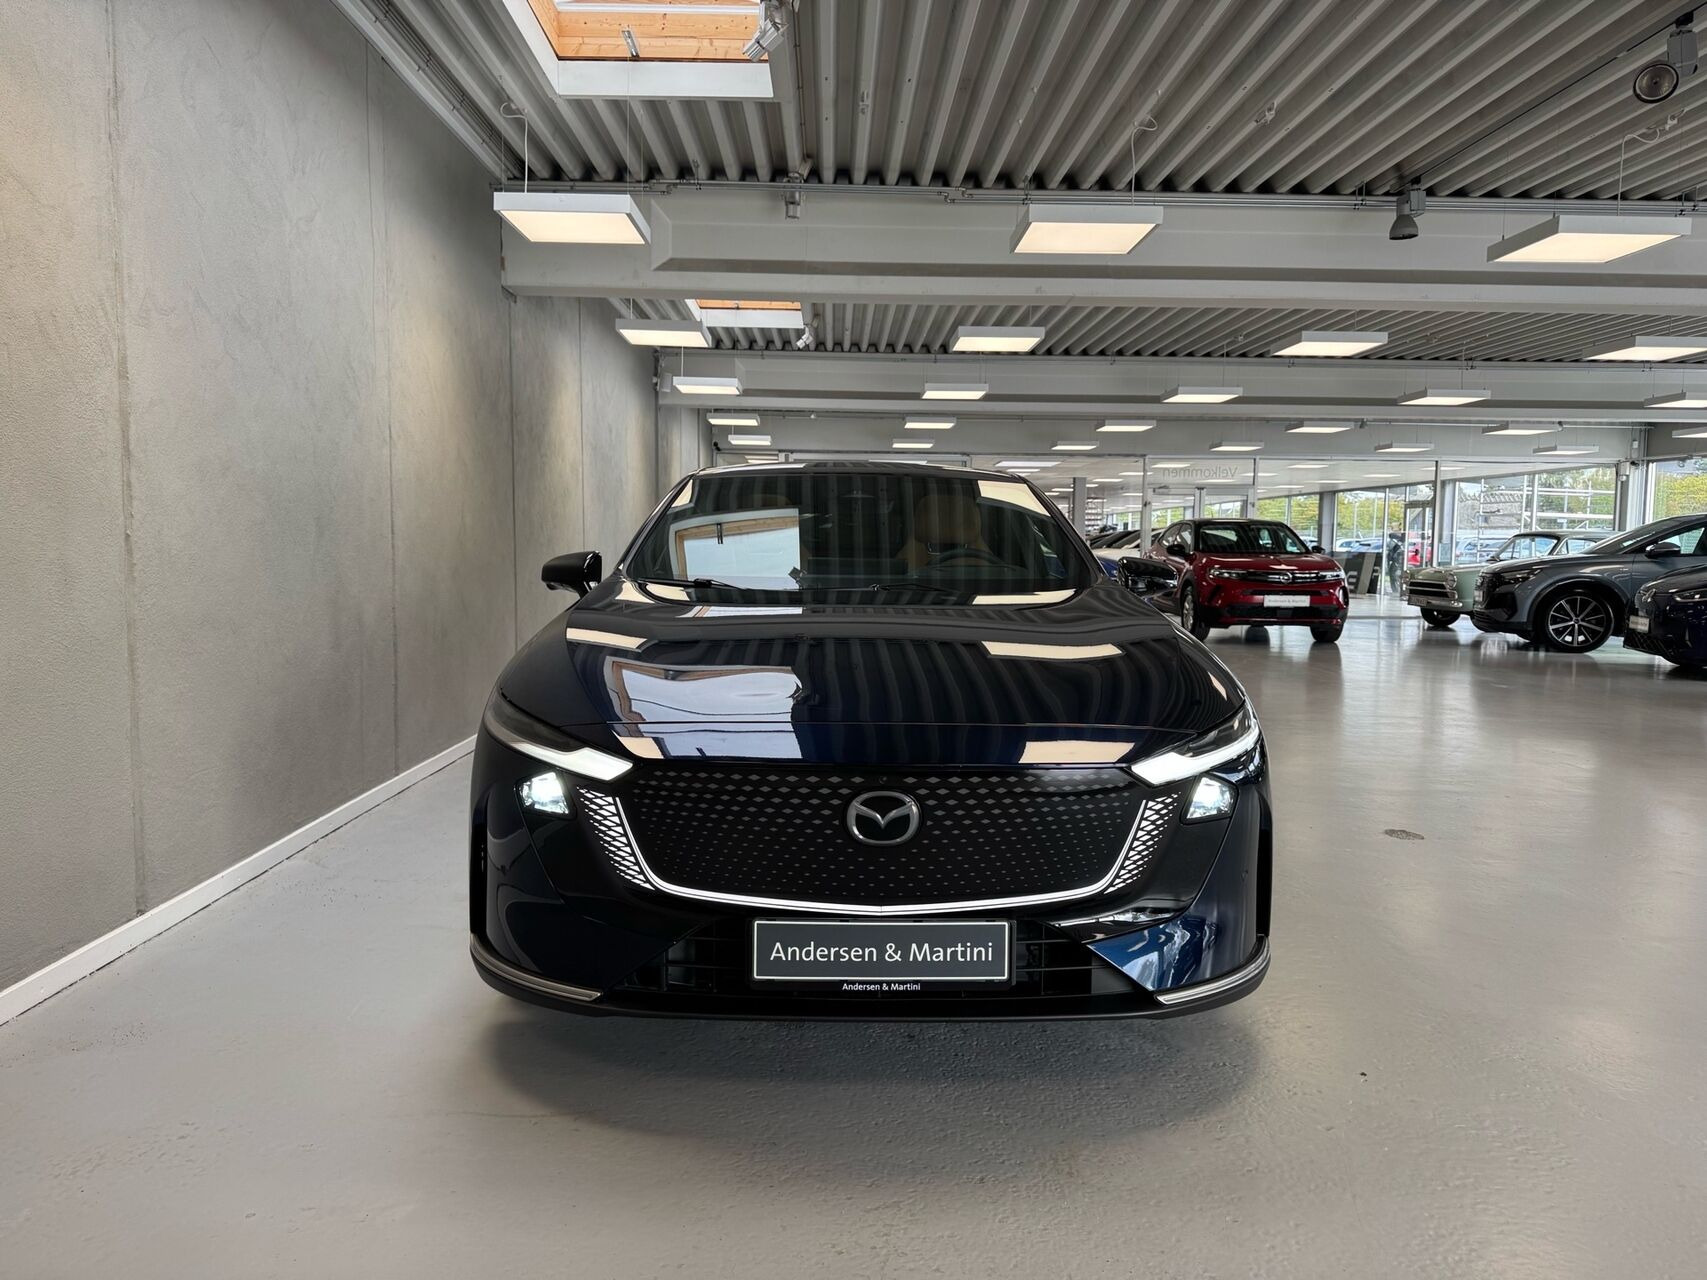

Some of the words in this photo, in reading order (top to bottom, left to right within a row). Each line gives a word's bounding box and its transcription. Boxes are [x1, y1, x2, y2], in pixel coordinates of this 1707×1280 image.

[770, 941, 877, 962] Andersen
[884, 943, 902, 962] &
[909, 942, 993, 962] Martini
[842, 983, 881, 991] Andersen
[882, 983, 889, 991] &
[890, 983, 921, 991] Martini
